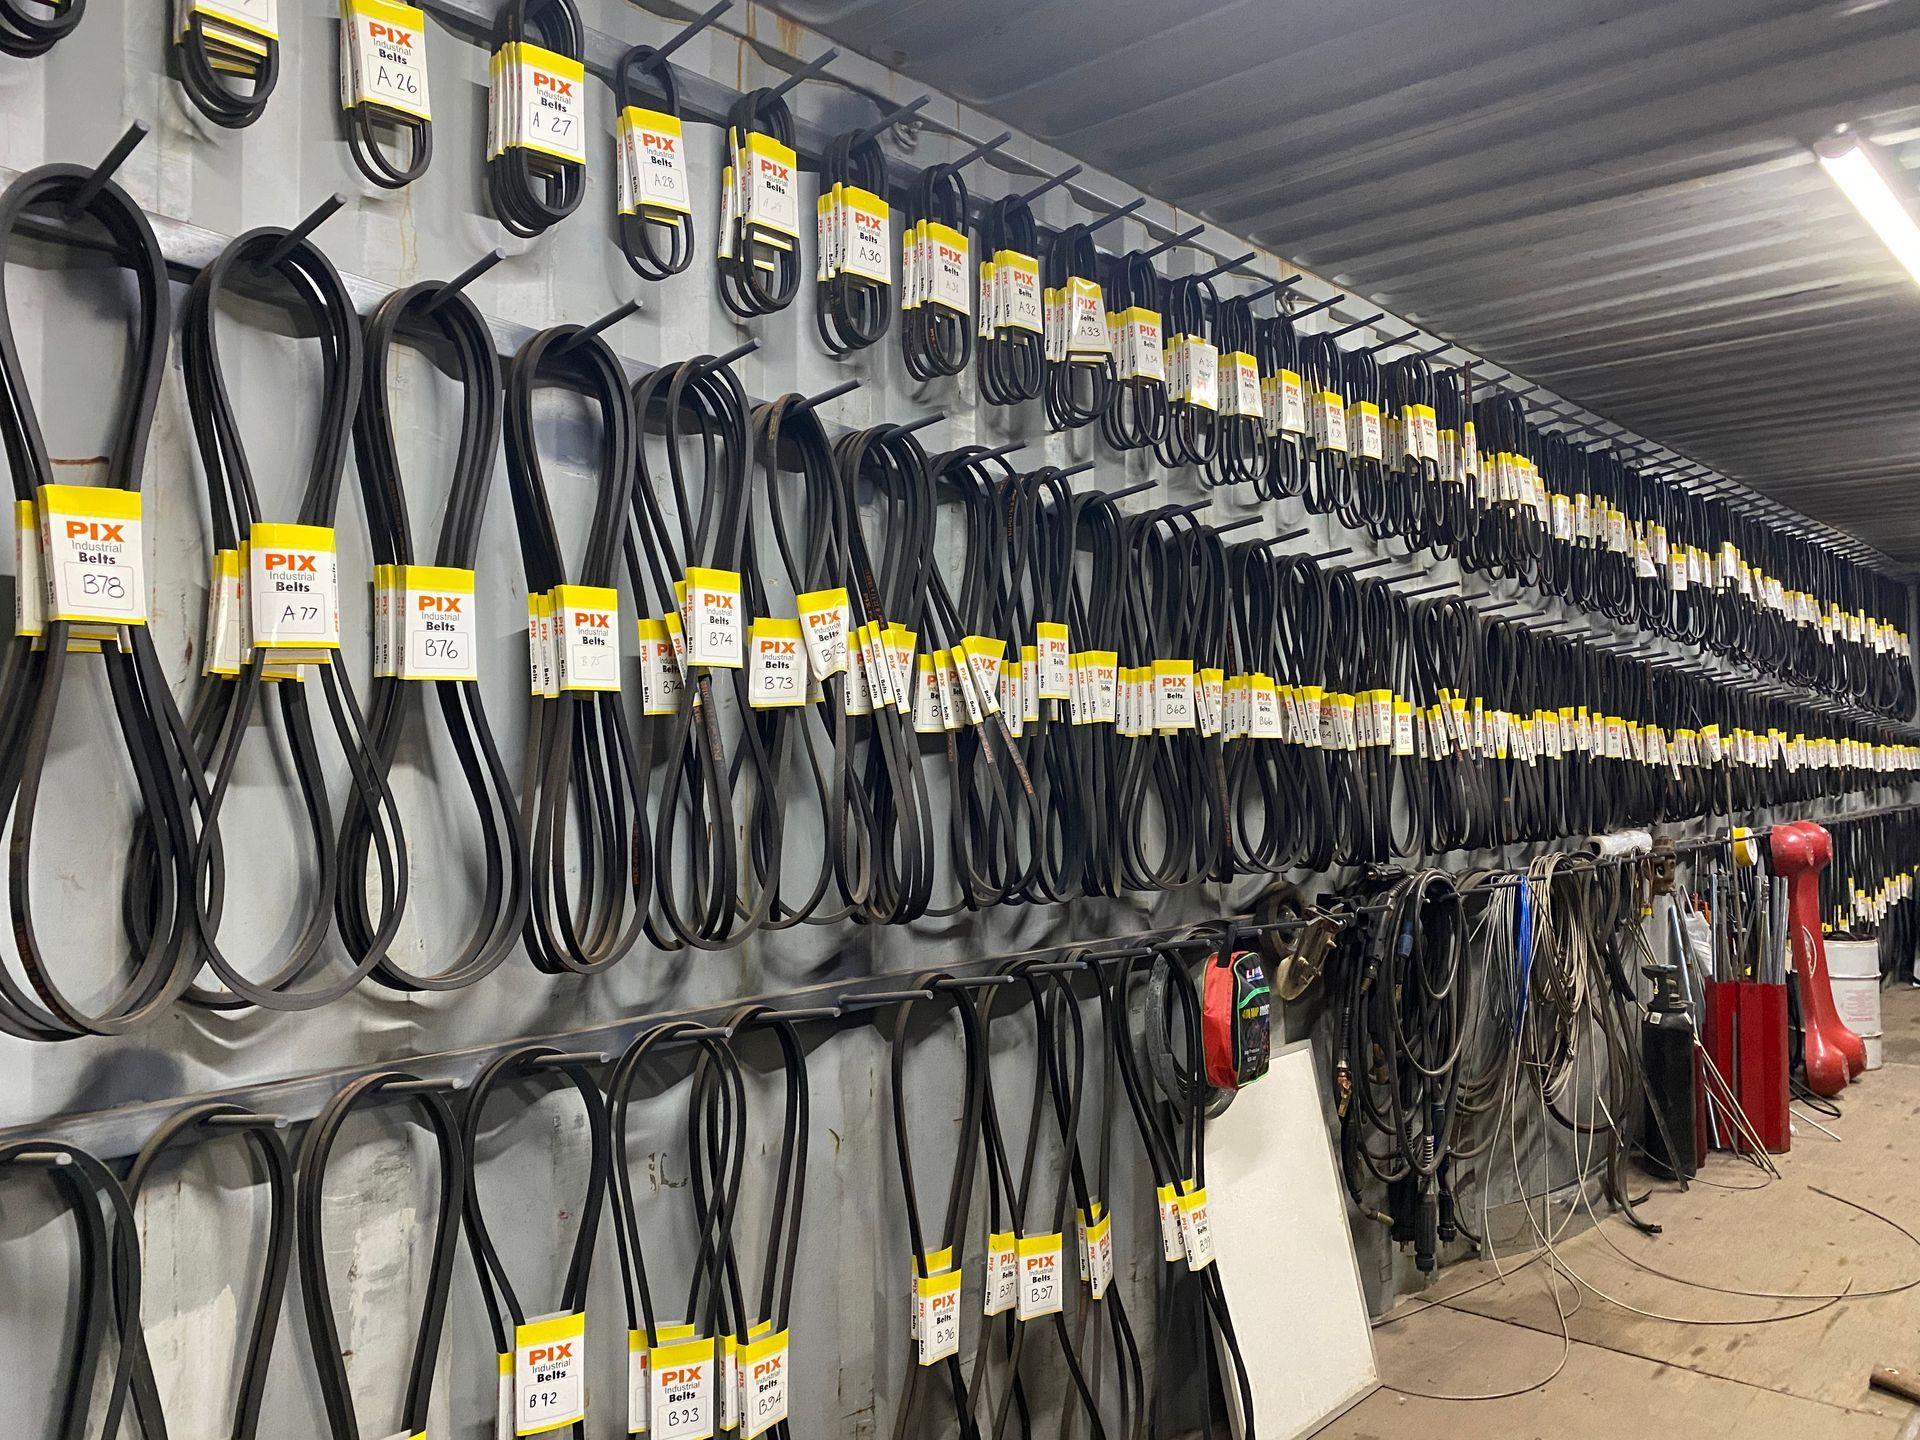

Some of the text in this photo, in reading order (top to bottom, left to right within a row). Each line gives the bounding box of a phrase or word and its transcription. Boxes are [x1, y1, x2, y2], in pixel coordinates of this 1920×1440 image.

[369, 22, 413, 48] PIX
[374, 38, 411, 56] Industrial
[379, 49, 407, 64] Belts
[534, 72, 572, 97] PIX
[537, 87, 571, 104] Industrial
[541, 98, 567, 112] Belts
[643, 133, 675, 152] PIX
[647, 148, 674, 159] Industrial
[651, 156, 672, 167] Belts
[761, 160, 788, 181] PIX
[767, 181, 785, 194] Belts
[855, 212, 881, 230] PIX
[860, 233, 877, 244] Belts
[859, 248, 881, 263] A30
[940, 247, 961, 264] PIX
[944, 265, 959, 276] Belts
[1014, 271, 1033, 286] PIX
[1019, 289, 1032, 298] Belts
[1019, 302, 1036, 316] A32
[1078, 297, 1096, 310] PIX
[1081, 327, 1100, 337] A33
[1139, 325, 1157, 337] PIX
[1241, 368, 1255, 379] PIX
[1286, 386, 1298, 396] PIX
[1330, 406, 1341, 416] PIX
[1366, 416, 1376, 425] PIX
[66, 521, 125, 542] PIX
[72, 540, 122, 553] Industrial
[79, 552, 116, 565] Belts
[265, 554, 318, 572] PIX
[269, 571, 315, 581] Industrial
[83, 574, 125, 598] B78
[276, 582, 310, 592] Belts
[419, 596, 461, 613] PIX
[704, 594, 733, 609] PIX
[422, 612, 460, 621] Industrial
[706, 608, 732, 616] Industrial
[575, 613, 609, 628] PIX
[710, 616, 729, 625] Belts
[809, 610, 841, 628] PIX
[426, 622, 455, 631] Belts
[578, 628, 608, 636] Industrial
[814, 622, 841, 634] Industrial
[583, 637, 605, 645] Belts
[819, 630, 839, 642] Belts
[426, 639, 458, 658] B76
[673, 638, 683, 656] PIX
[761, 641, 796, 654] PIX
[1050, 642, 1065, 653] PIX
[766, 661, 790, 669] Belts
[1098, 669, 1113, 679] PIX
[765, 677, 794, 689] B73
[1163, 678, 1186, 687] PIX
[1257, 692, 1271, 701] PIX
[1192, 1208, 1207, 1223] PIX
[1027, 1255, 1055, 1270] PIX
[1032, 1275, 1050, 1283] Belts
[1031, 1286, 1053, 1302] B97
[932, 1293, 955, 1311] PIX
[937, 1315, 952, 1325] Belts
[529, 1343, 572, 1365] PIX
[532, 1359, 570, 1374] Industrial
[754, 1356, 781, 1379] PIX
[538, 1370, 566, 1383] Belts
[662, 1366, 702, 1386] PIX
[756, 1371, 780, 1386] Industrial
[665, 1382, 700, 1394] Industrial
[759, 1379, 777, 1392] Belts
[669, 1391, 696, 1402] Belts
